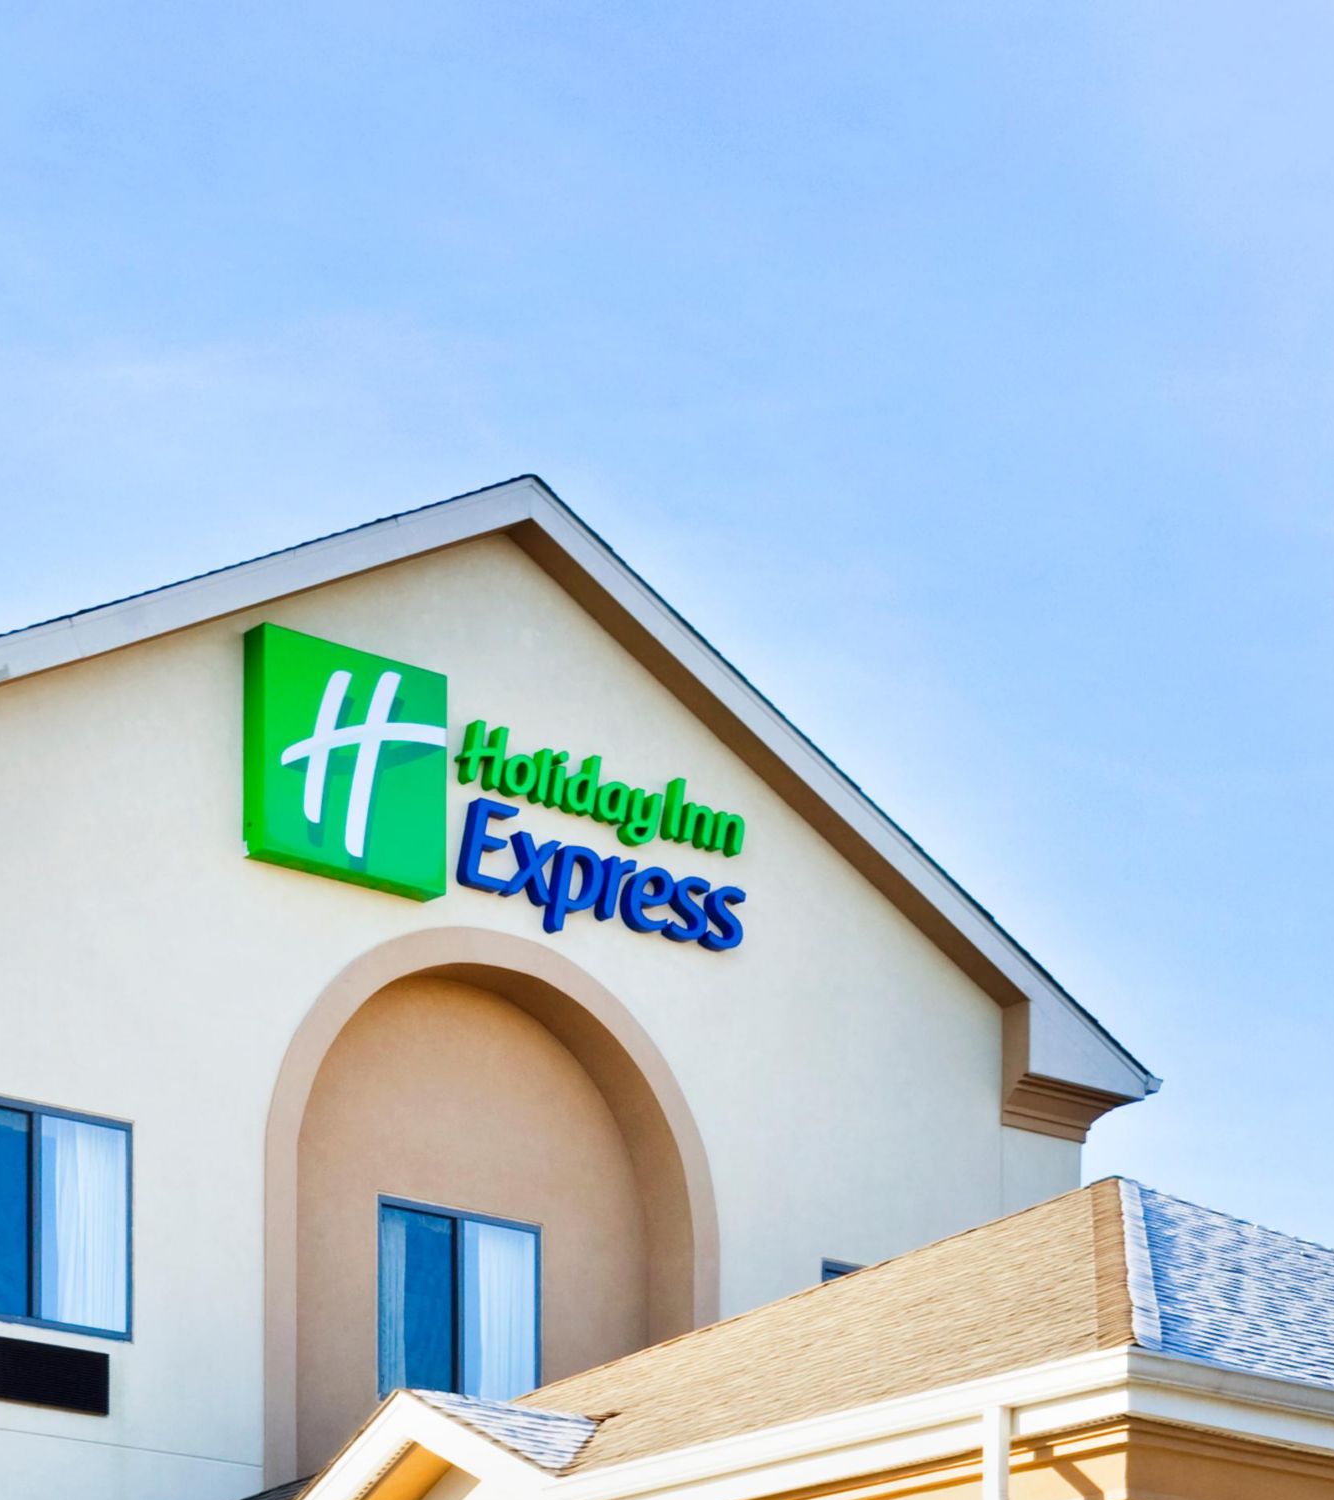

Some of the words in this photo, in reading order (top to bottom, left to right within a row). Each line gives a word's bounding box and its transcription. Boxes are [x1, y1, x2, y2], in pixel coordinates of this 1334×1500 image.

[454, 720, 663, 847] Holiday
[660, 777, 746, 857] Inn
[456, 798, 746, 952] Express
